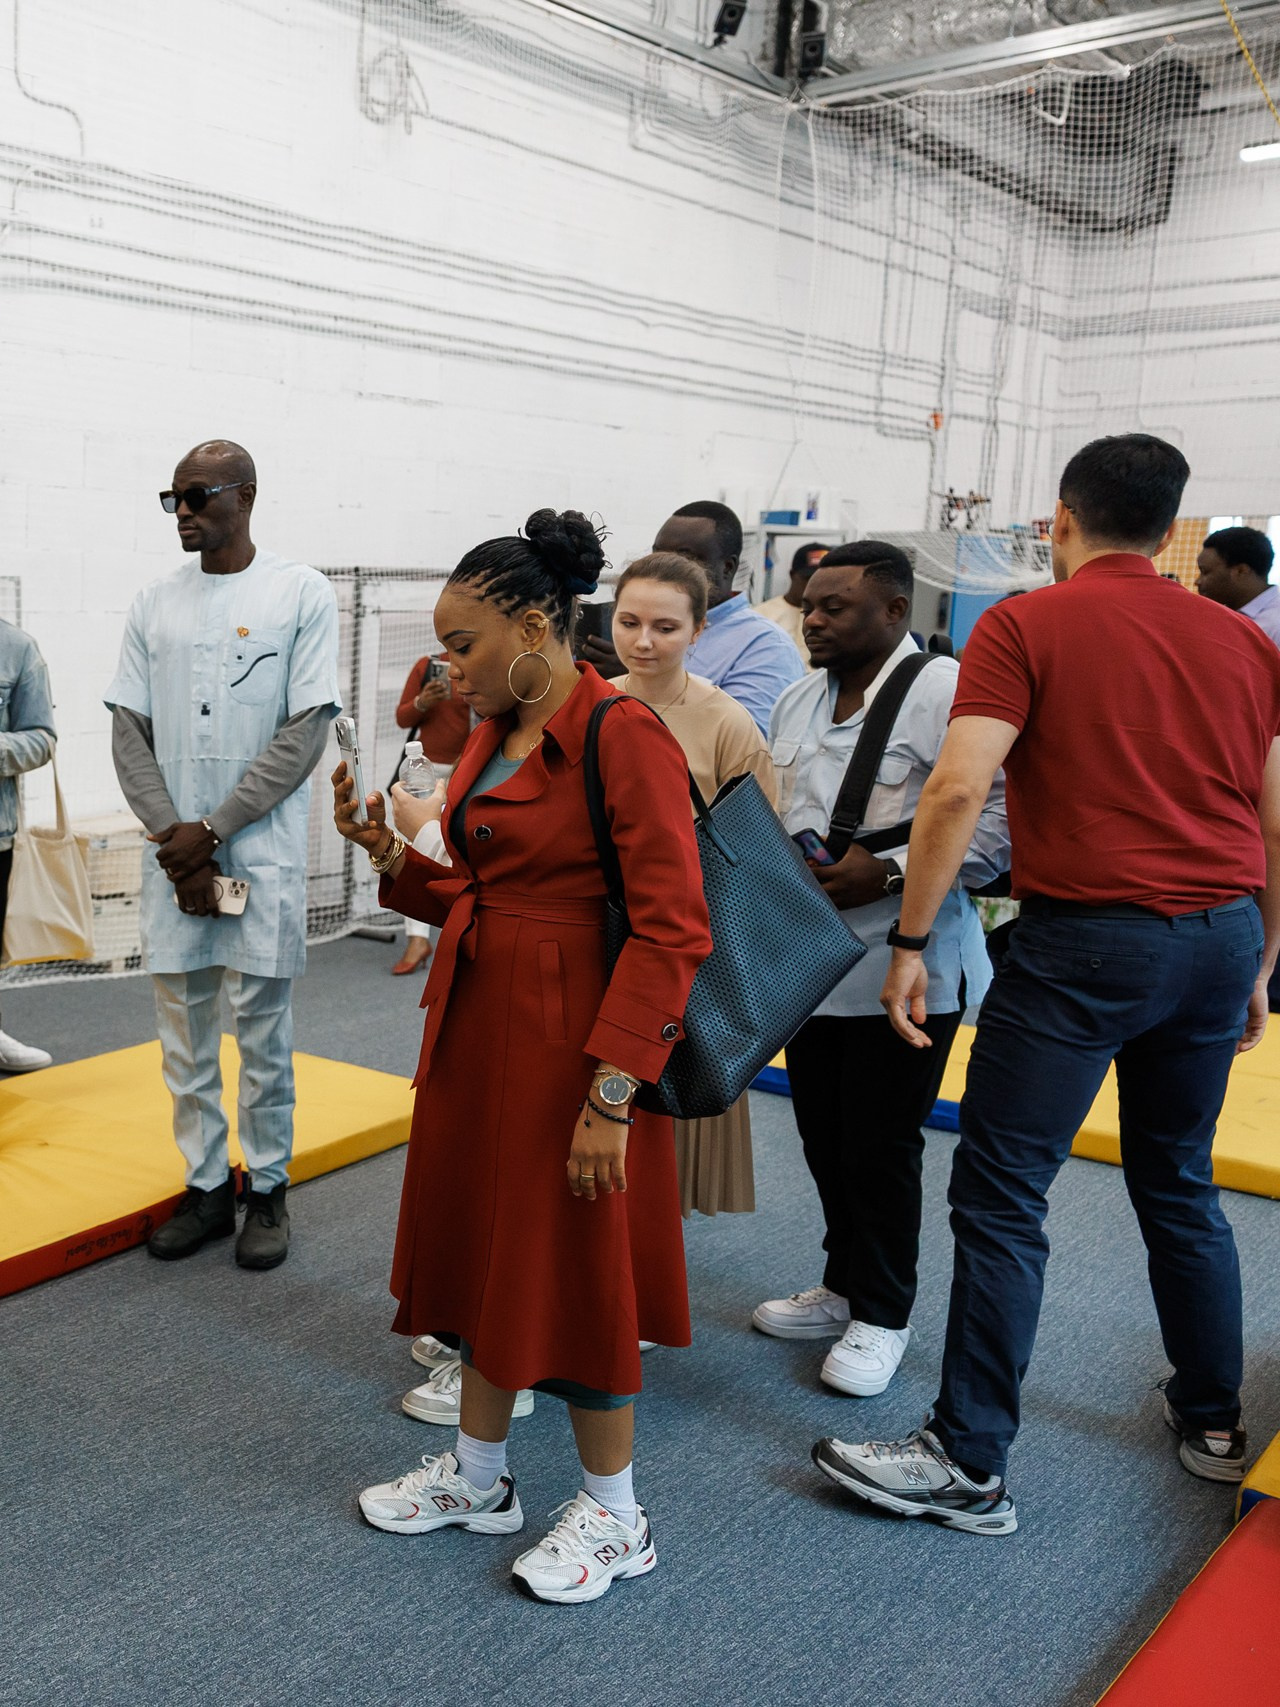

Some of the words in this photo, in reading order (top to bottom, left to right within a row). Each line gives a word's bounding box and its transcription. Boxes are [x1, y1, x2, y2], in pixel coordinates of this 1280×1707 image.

[897, 1463, 932, 1486] N
[431, 1494, 459, 1512] N
[593, 1544, 619, 1567] N
